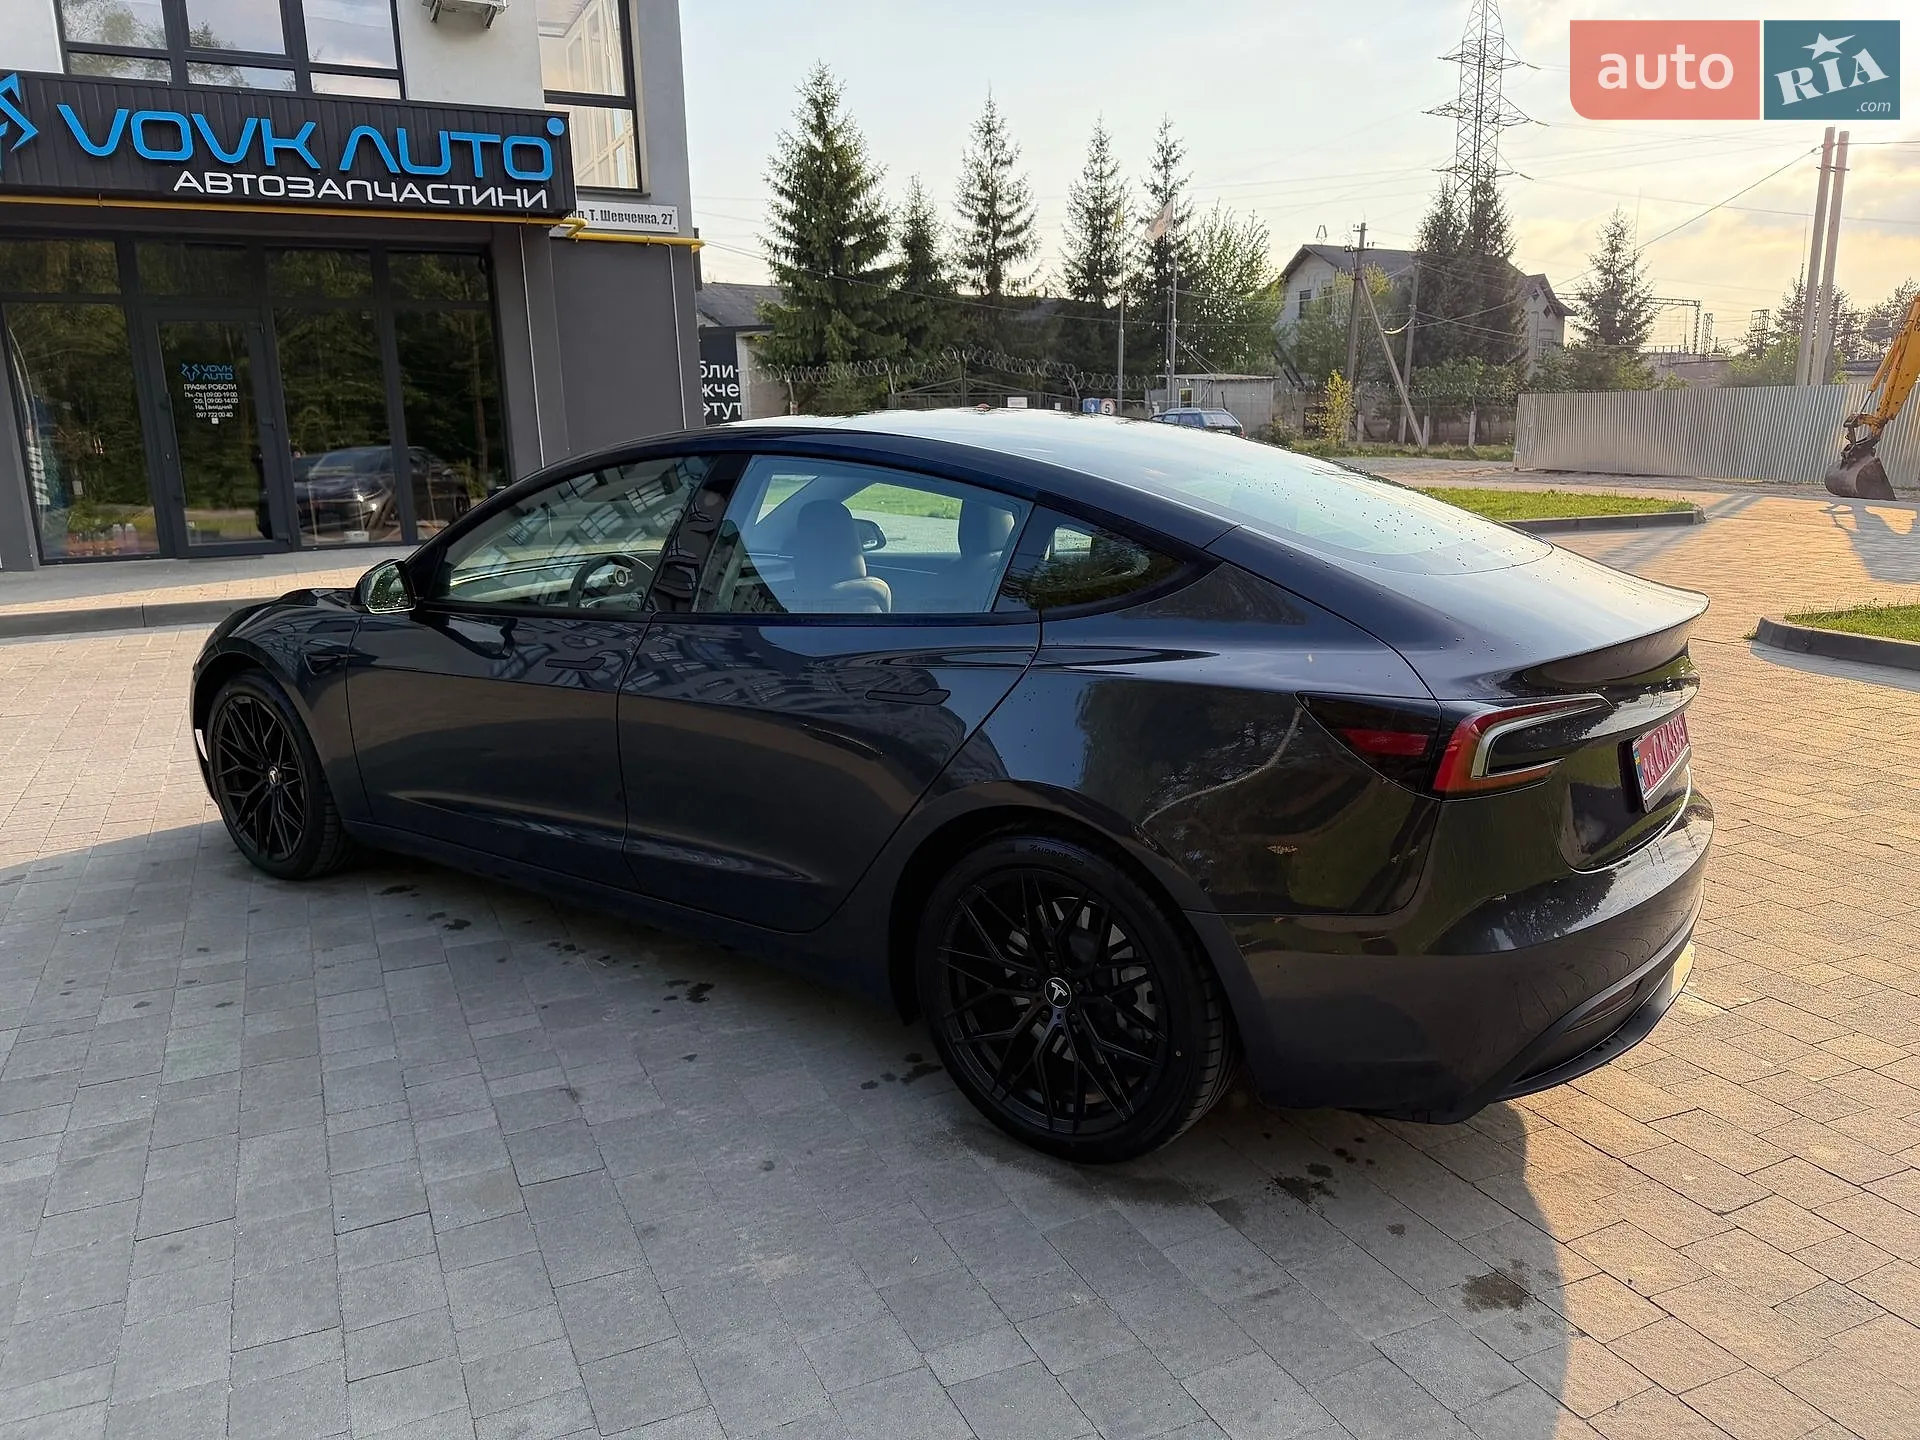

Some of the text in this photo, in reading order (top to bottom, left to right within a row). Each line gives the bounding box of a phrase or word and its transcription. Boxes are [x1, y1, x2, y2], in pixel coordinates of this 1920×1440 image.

[57, 104, 553, 181] VOVK AUTO
[173, 170, 548, 209] АВТОЗАПЧАСТИНИ
[588, 209, 599, 221] Т.
[600, 210, 660, 225] Шевченка,
[661, 213, 673, 225] 27
[201, 365, 233, 373] VOVK
